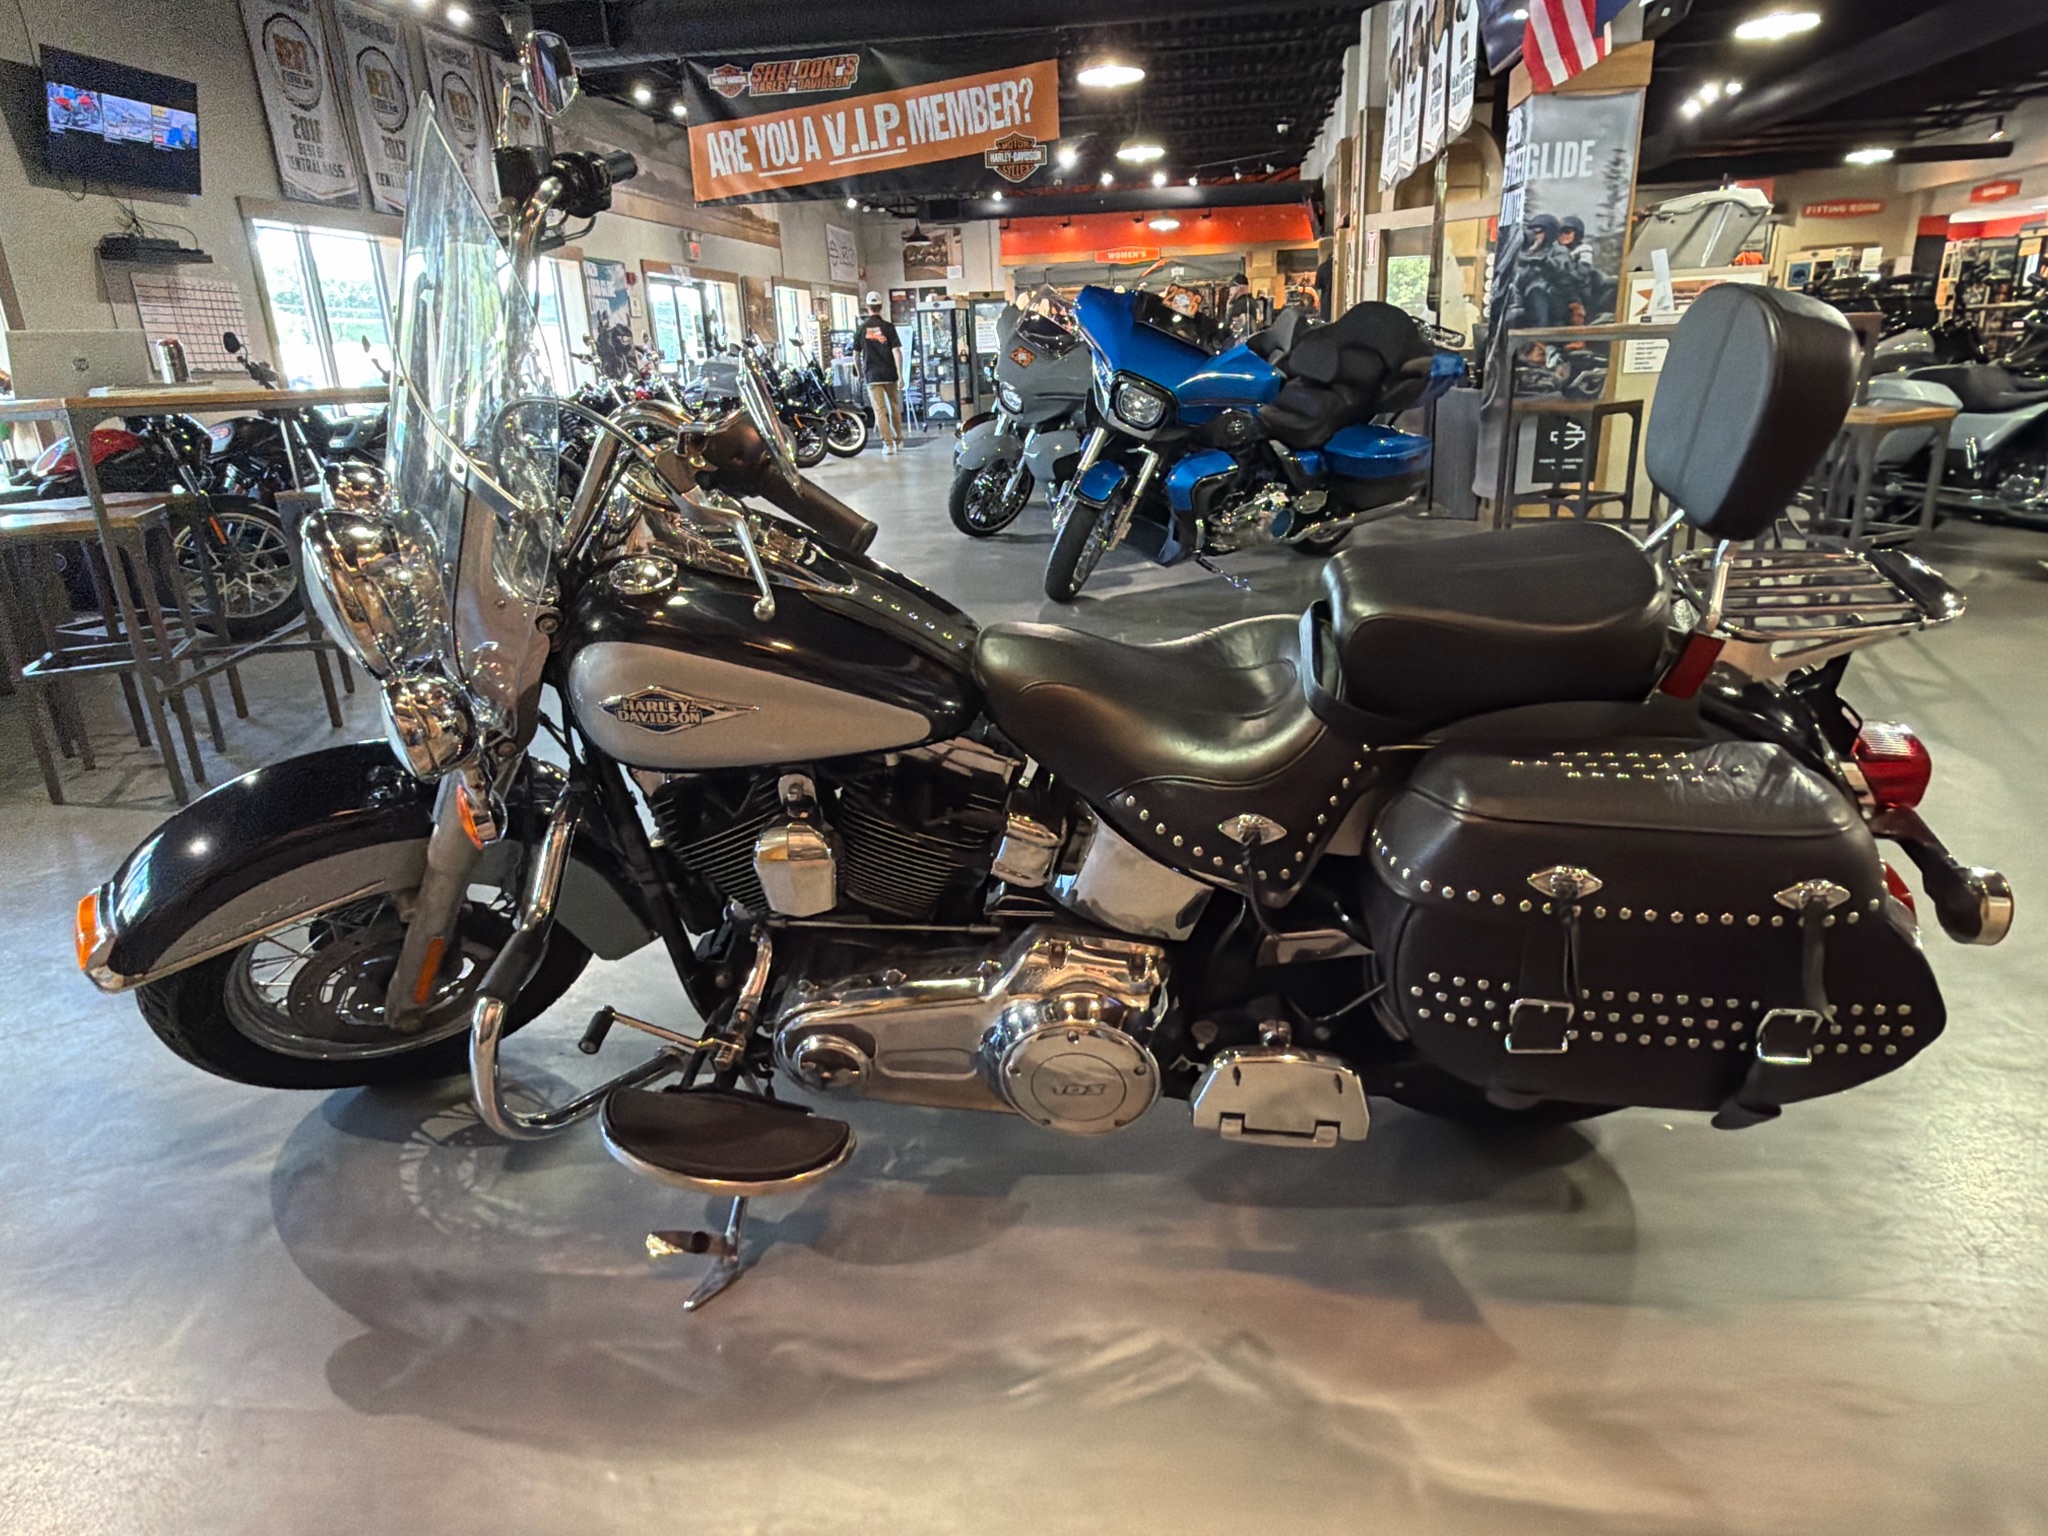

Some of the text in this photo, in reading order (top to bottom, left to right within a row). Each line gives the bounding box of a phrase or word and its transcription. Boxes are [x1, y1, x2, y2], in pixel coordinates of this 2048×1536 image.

[751, 55, 858, 82] SHELDON'S
[706, 76, 1035, 178] ARE YOU A V.I.P. MEMBER?
[1527, 139, 1597, 179] GLIDE
[1107, 250, 1147, 260] WOMEN'S
[617, 710, 700, 724] DAVIDSON
